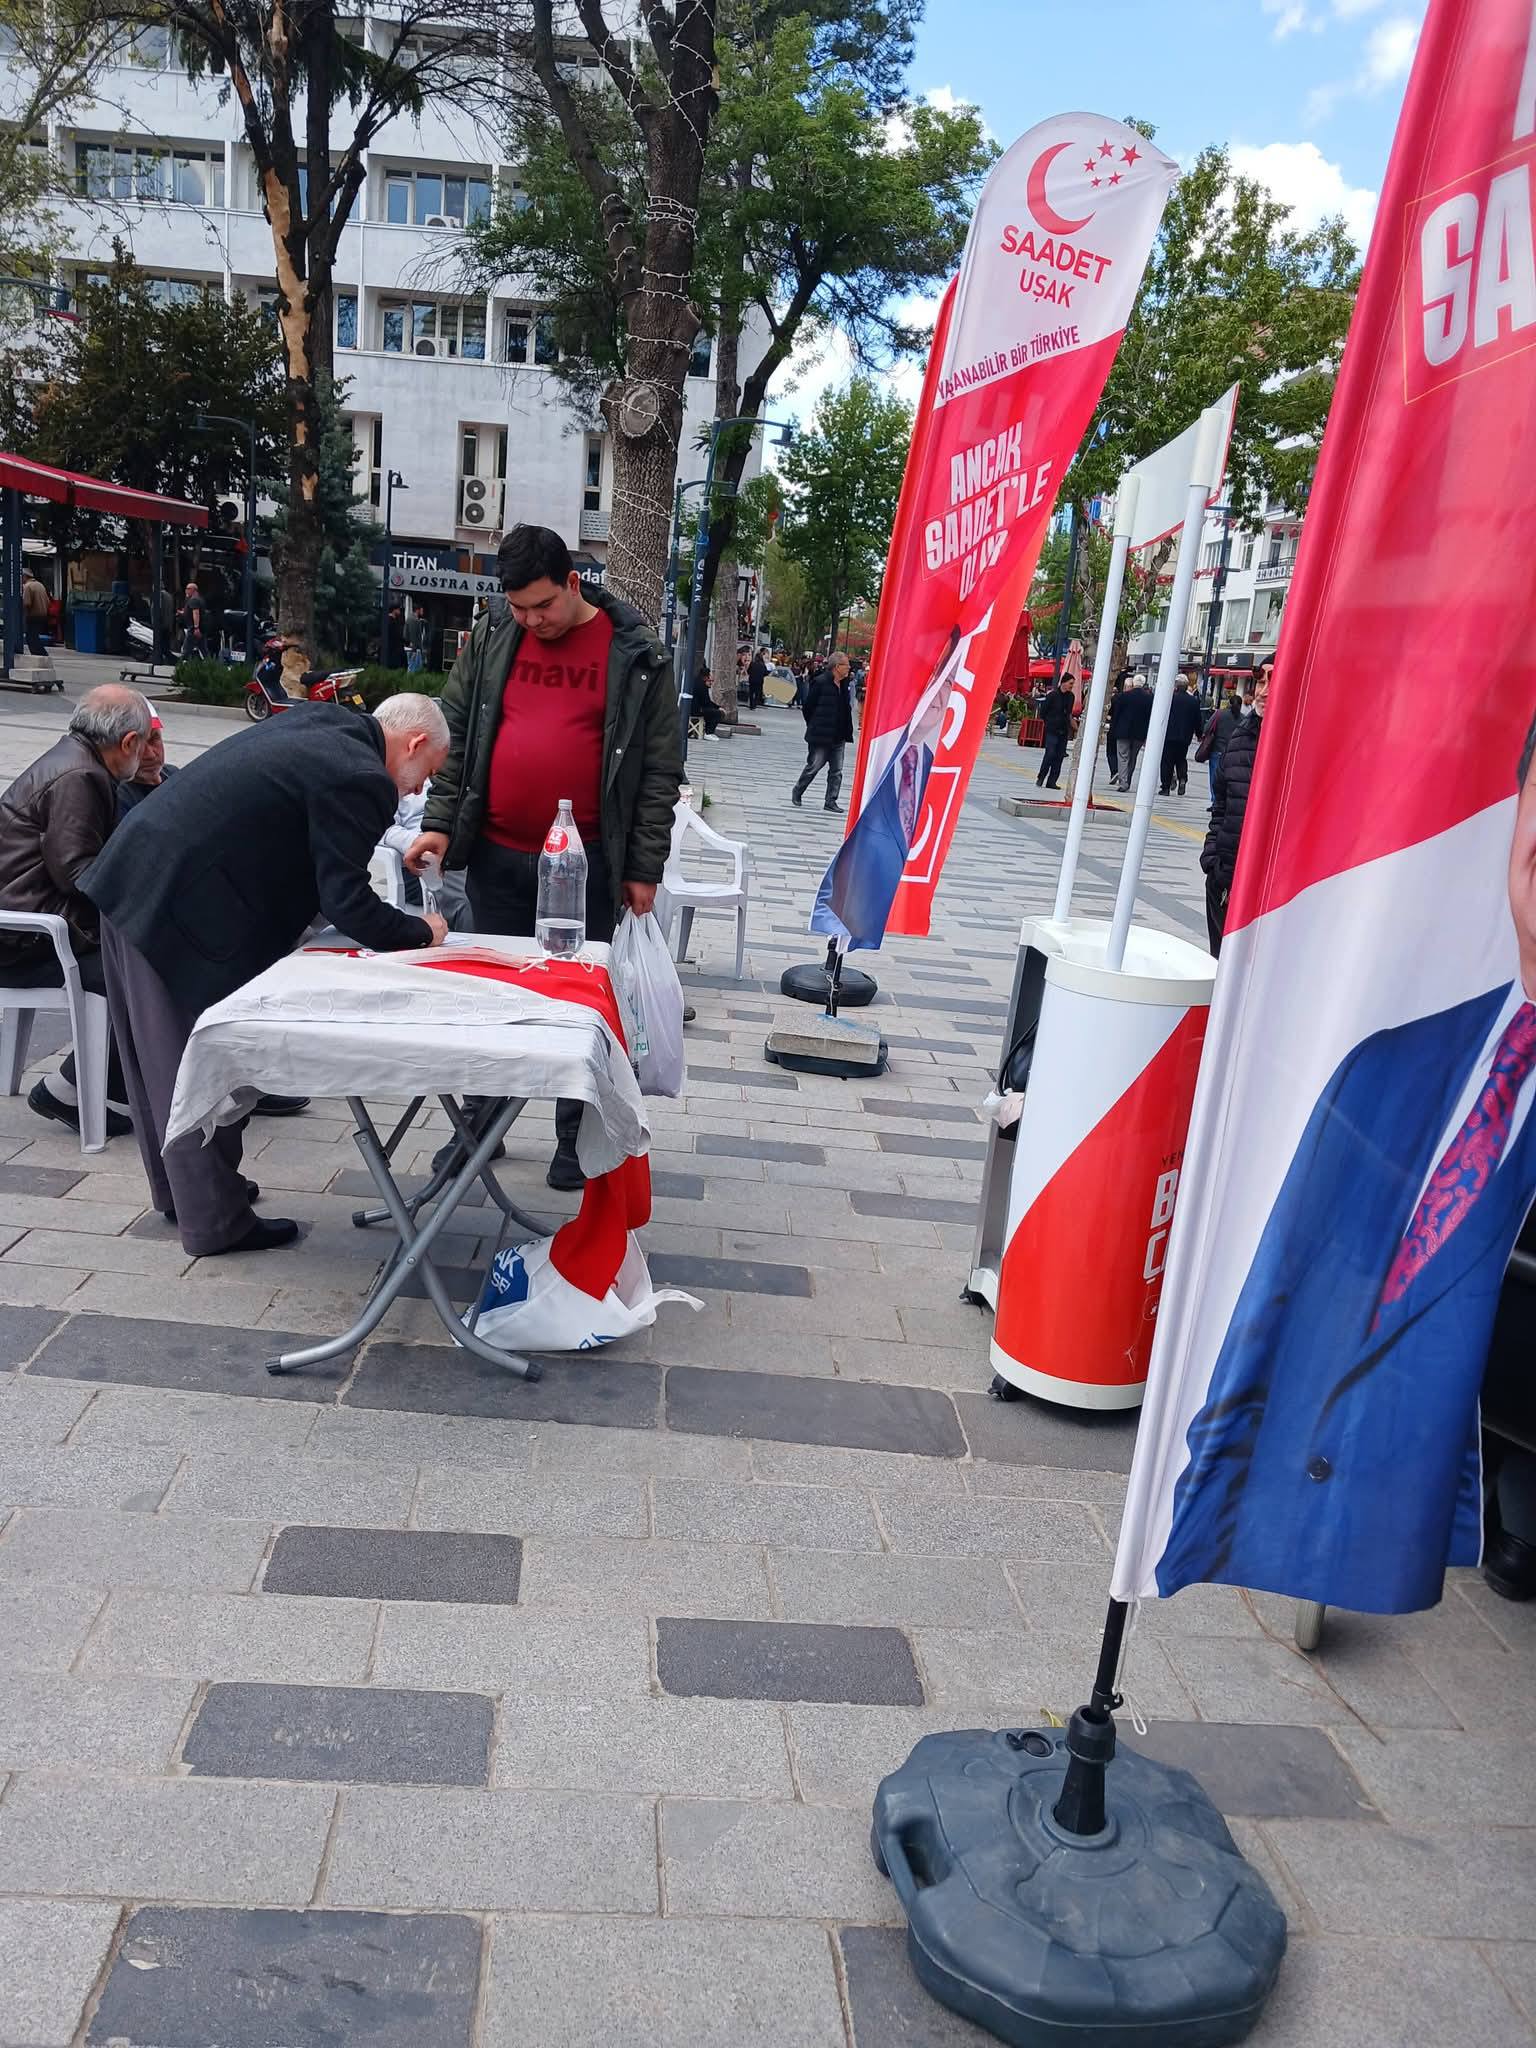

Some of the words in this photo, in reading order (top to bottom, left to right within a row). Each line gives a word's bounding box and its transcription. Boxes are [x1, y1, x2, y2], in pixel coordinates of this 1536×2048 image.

[1000, 224, 1112, 284] SAADET
[1019, 268, 1076, 309] UŞAK
[1012, 342, 1028, 368] BİR
[1030, 324, 1081, 358] TÜRKİYE
[951, 421, 1023, 506] ANCAK
[392, 551, 437, 571] TİTAN
[410, 575, 468, 591] LOSTRA
[513, 659, 600, 691] mavi
